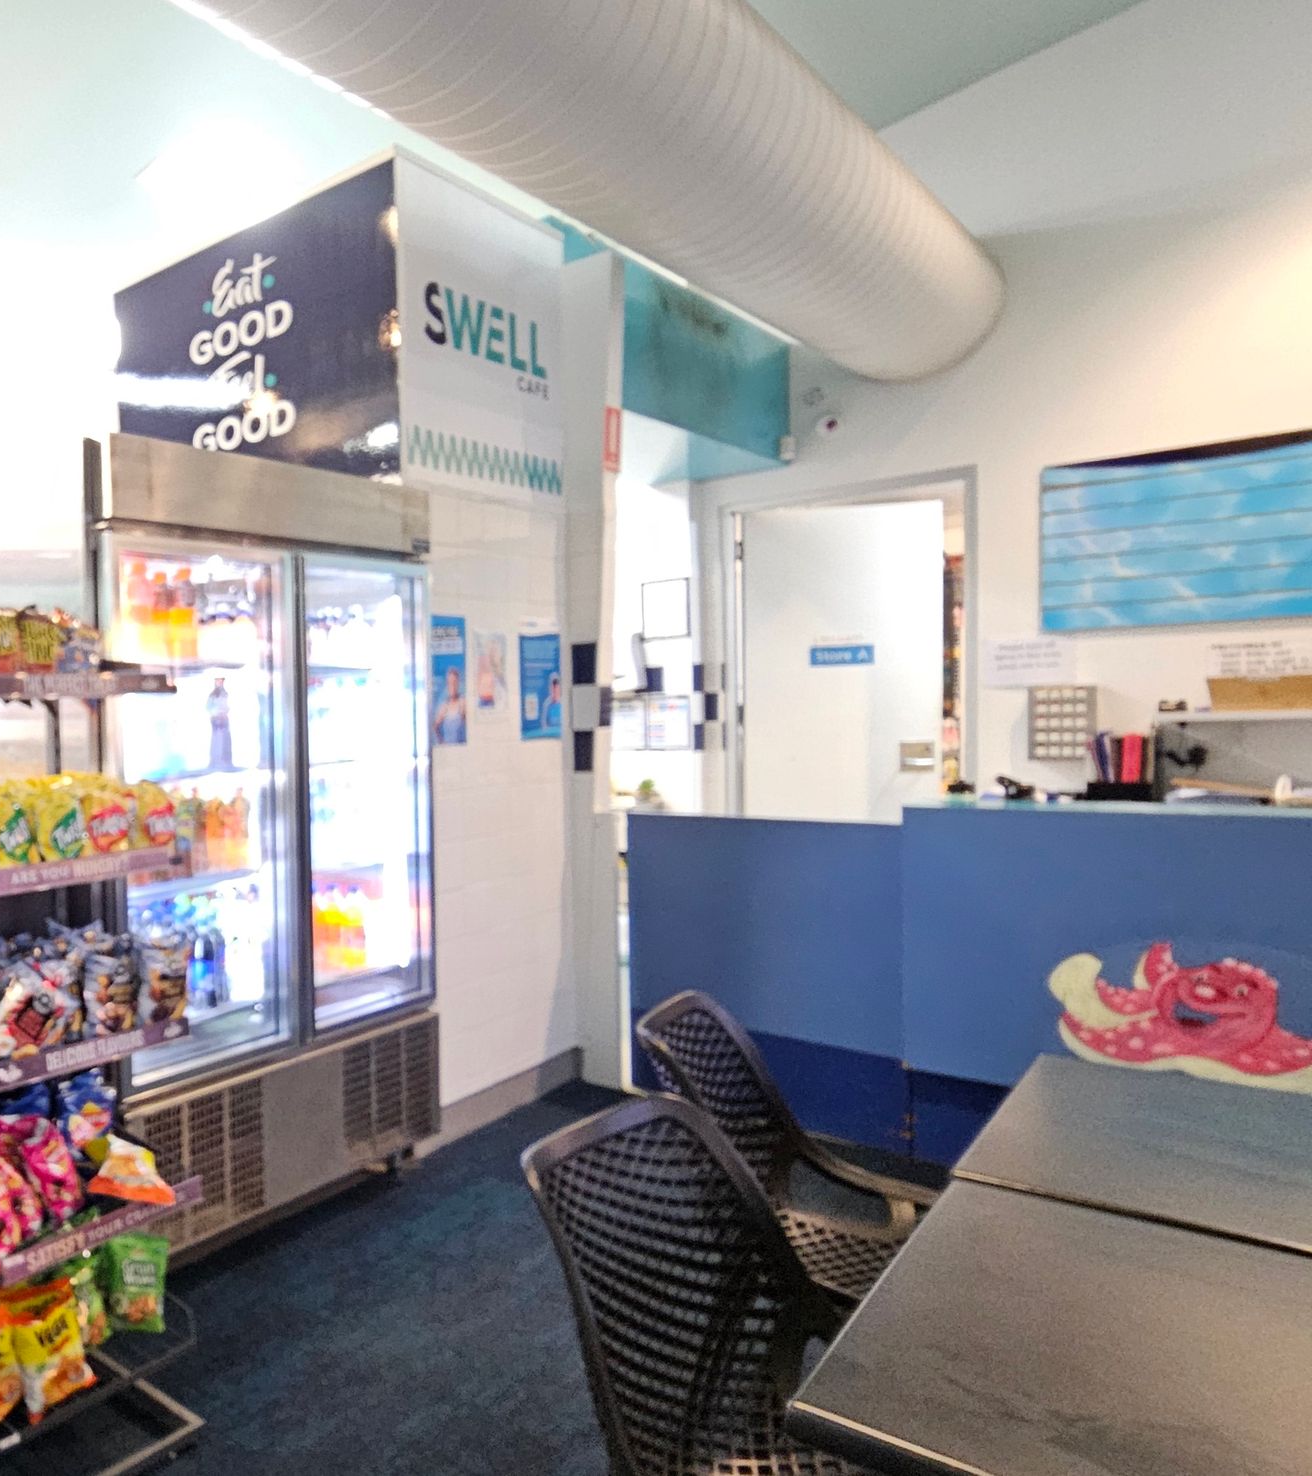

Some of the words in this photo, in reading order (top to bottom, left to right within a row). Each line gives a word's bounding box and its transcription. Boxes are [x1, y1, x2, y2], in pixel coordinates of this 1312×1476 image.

[211, 253, 278, 318] Eat
[189, 300, 294, 365] GOOD
[424, 281, 547, 380] SWELL
[516, 375, 551, 401] CAFE
[193, 400, 296, 451] GOOD
[10, 869, 39, 886] ARE
[40, 865, 70, 882] YOU
[25, 1231, 86, 1271] SATISFY
[88, 1217, 123, 1240] YOUR
